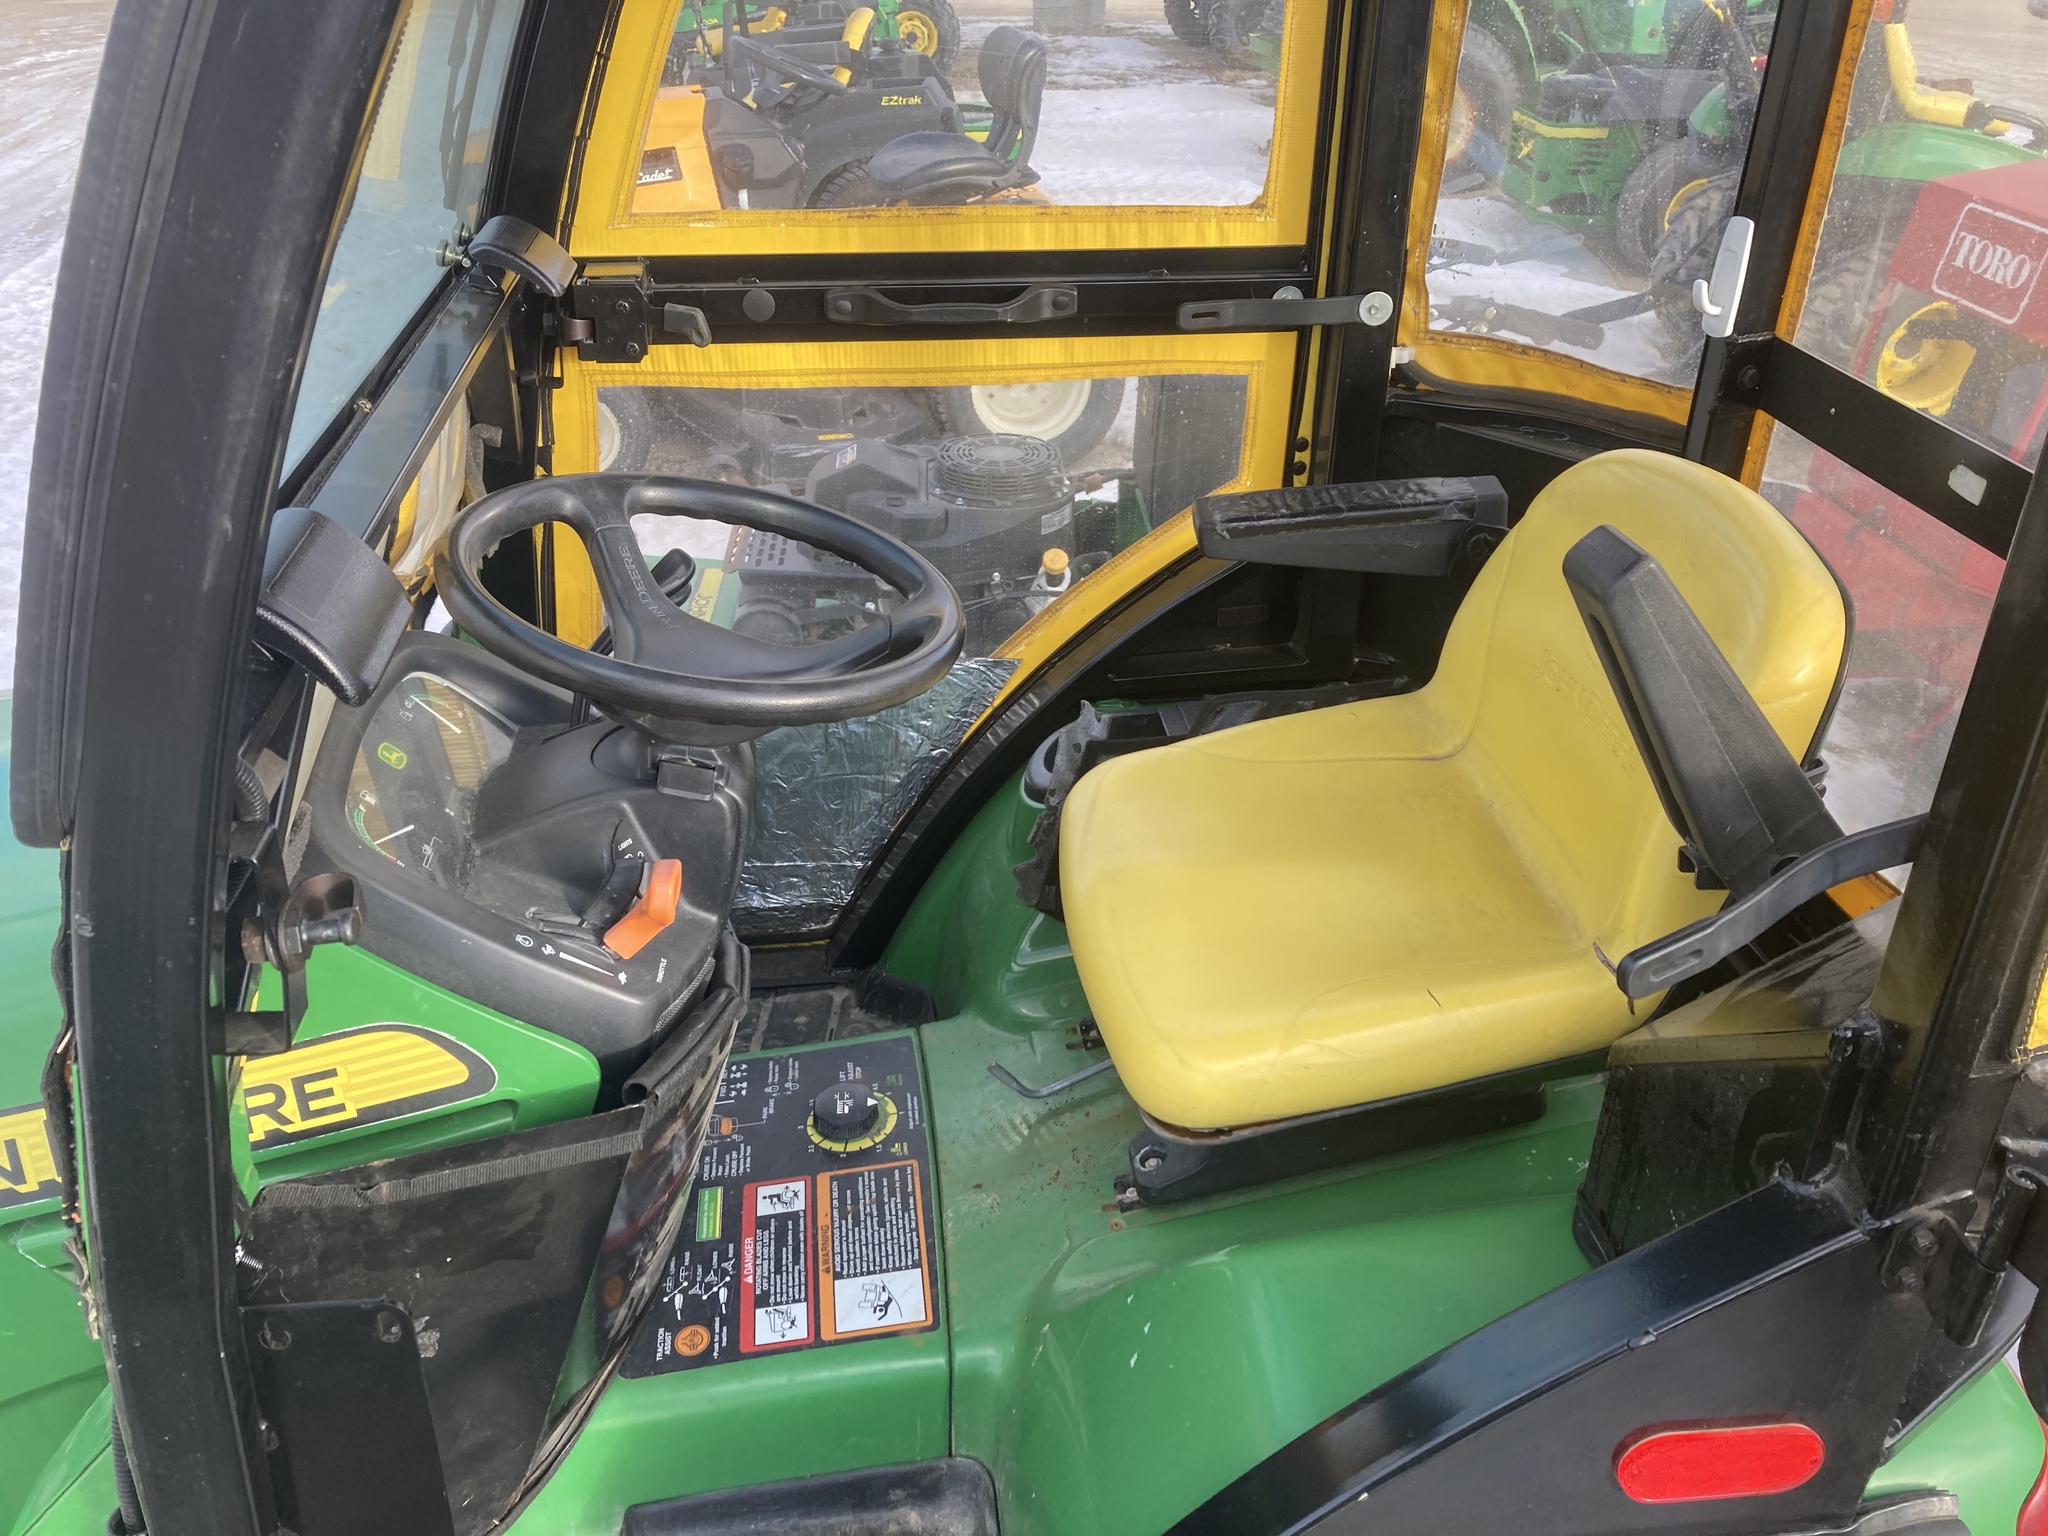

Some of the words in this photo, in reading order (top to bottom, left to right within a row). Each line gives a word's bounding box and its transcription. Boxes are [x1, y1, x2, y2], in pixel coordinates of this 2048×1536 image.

[880, 95, 922, 106] EZtrak
[1951, 231, 2031, 289] TORO
[618, 545, 654, 605] DEERE
[1530, 648, 1586, 715] JOHN
[617, 837, 633, 852] LIGHTS
[656, 957, 668, 983] THROTTLE
[833, 1199, 839, 1207] OR
[744, 1237, 754, 1274] DANGER
[821, 1225, 830, 1265] WARNING
[656, 1328, 664, 1361] TRACTION
